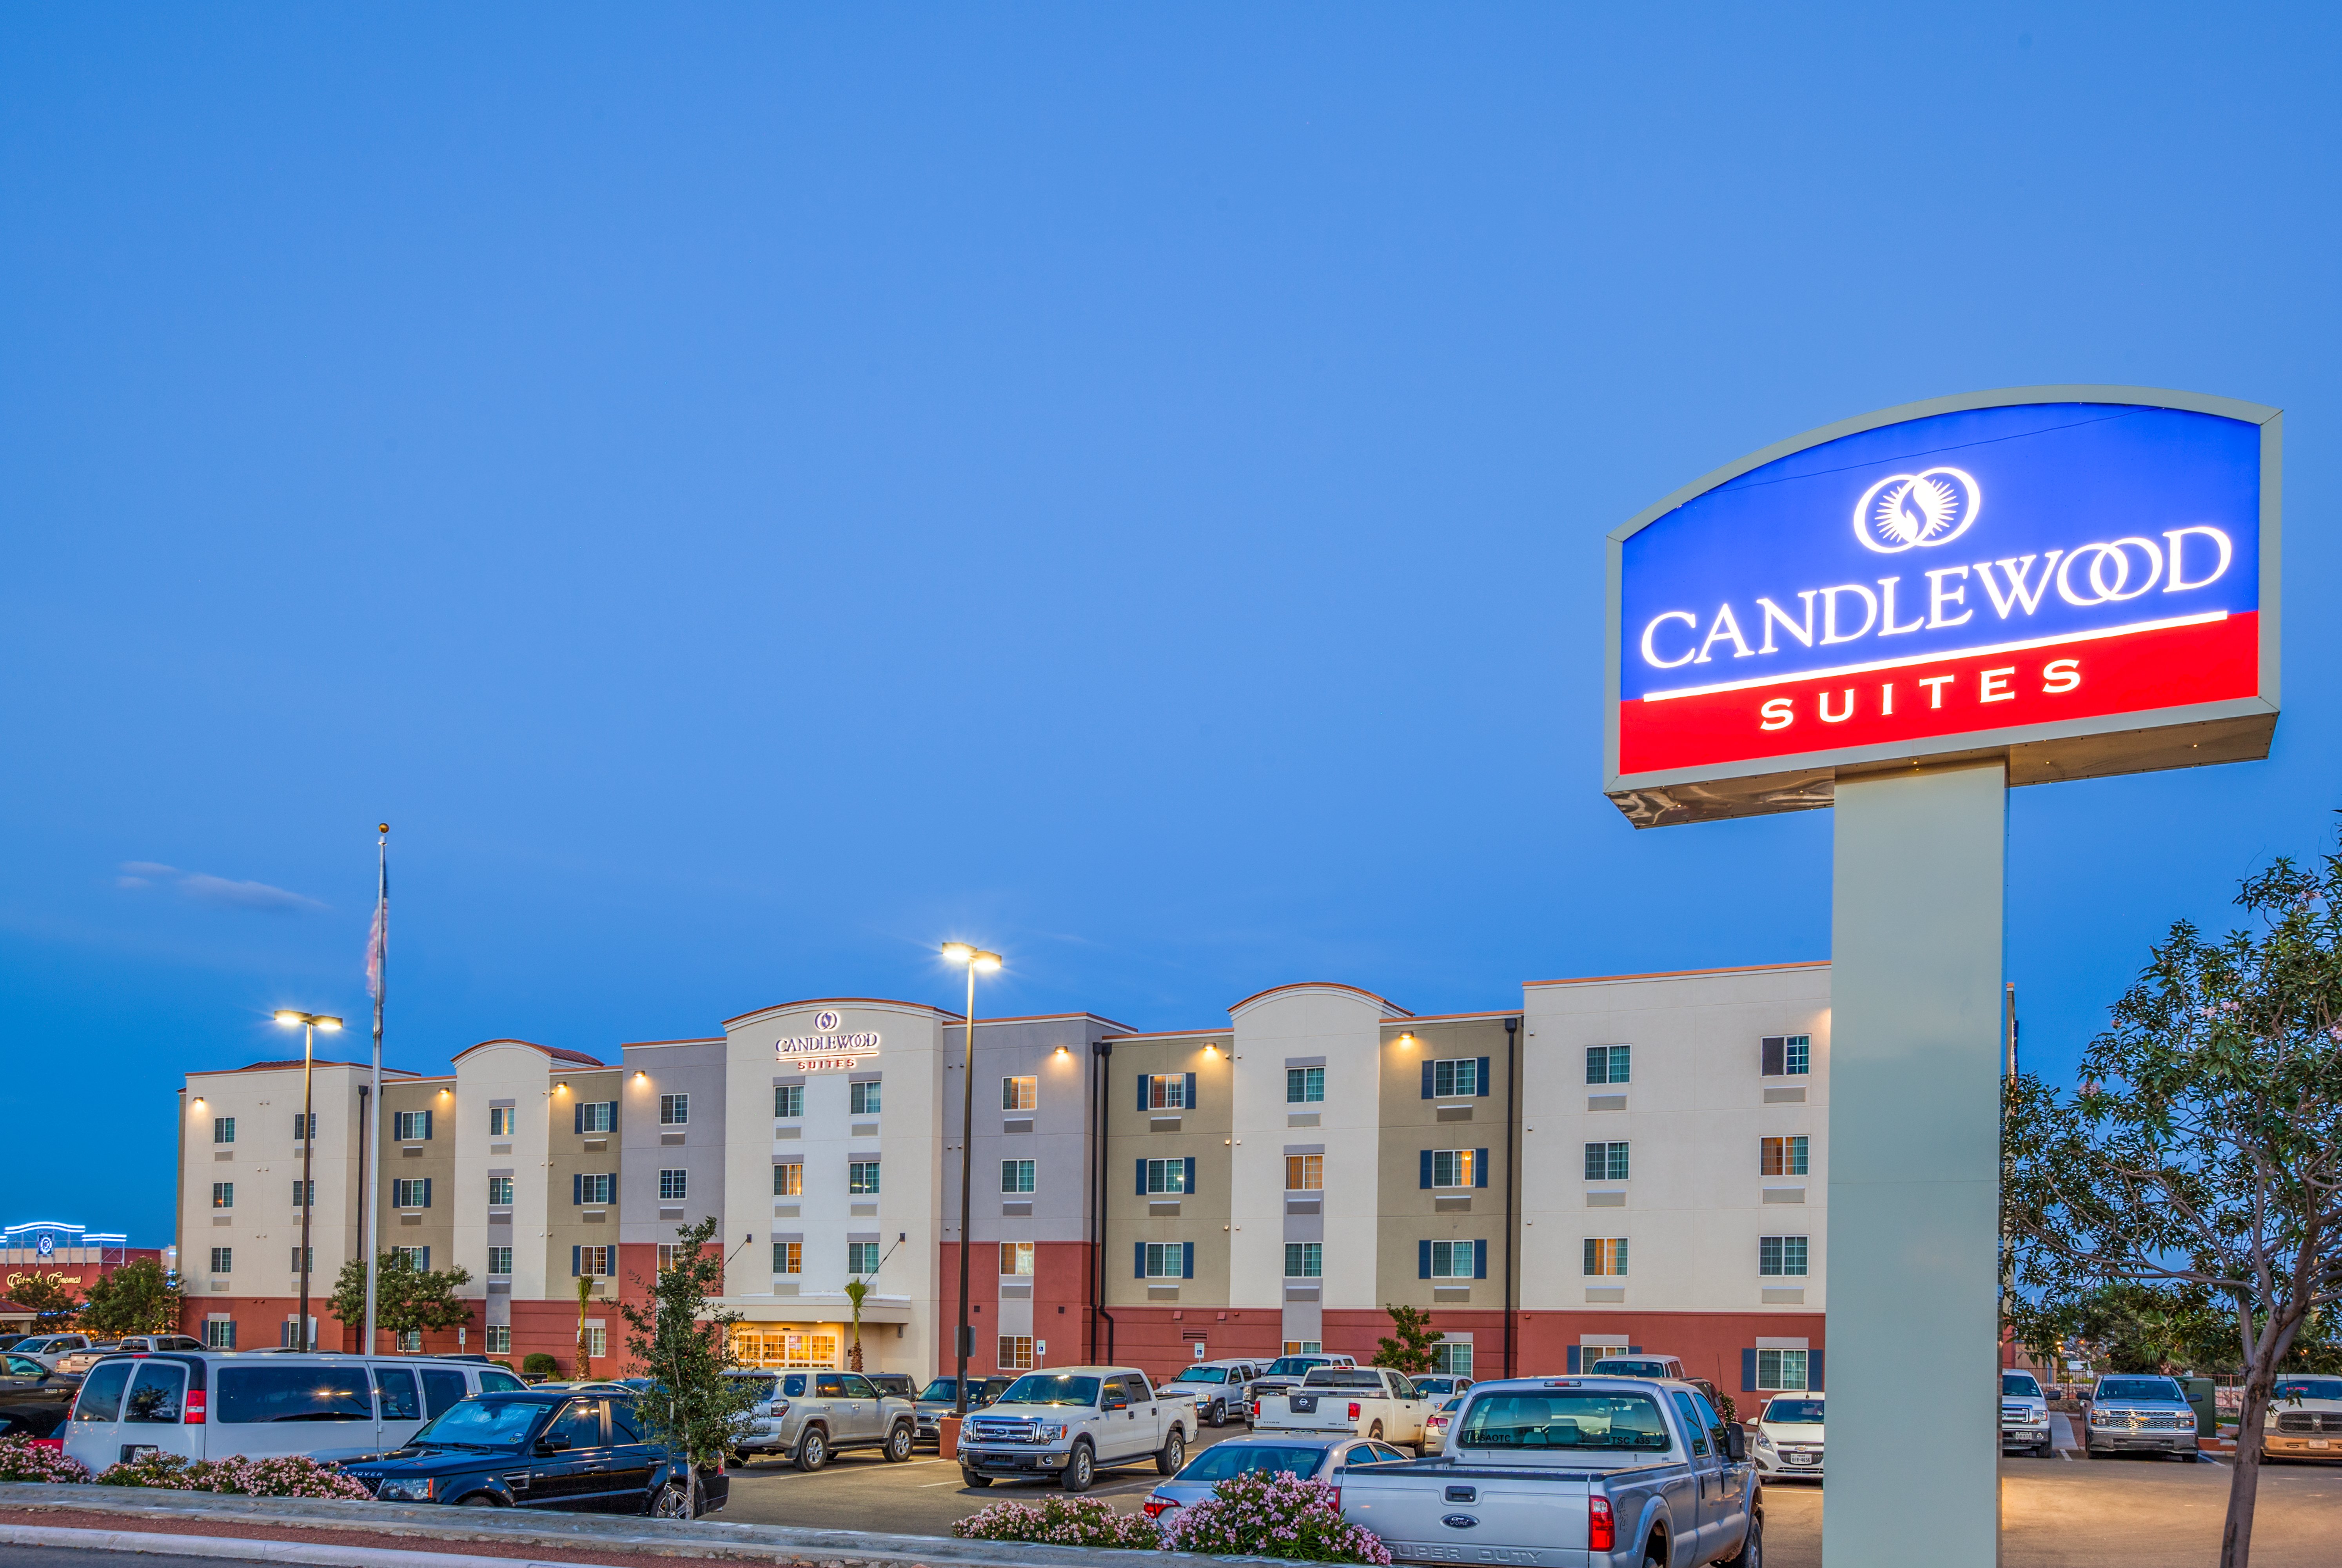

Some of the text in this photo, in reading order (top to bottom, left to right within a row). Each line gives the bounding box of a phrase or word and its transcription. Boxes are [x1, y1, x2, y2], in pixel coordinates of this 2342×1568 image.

[1641, 526, 2233, 669] CANDLEWOOD
[1760, 659, 2081, 730] SUITES
[775, 1033, 877, 1053] CANDLEWOOD
[798, 1059, 855, 1069] SUITES
[47, 1271, 82, 1289] Cinemas
[1450, 1517, 1469, 1526] Ford
[1385, 1544, 1542, 1563] SUPER DUTY
